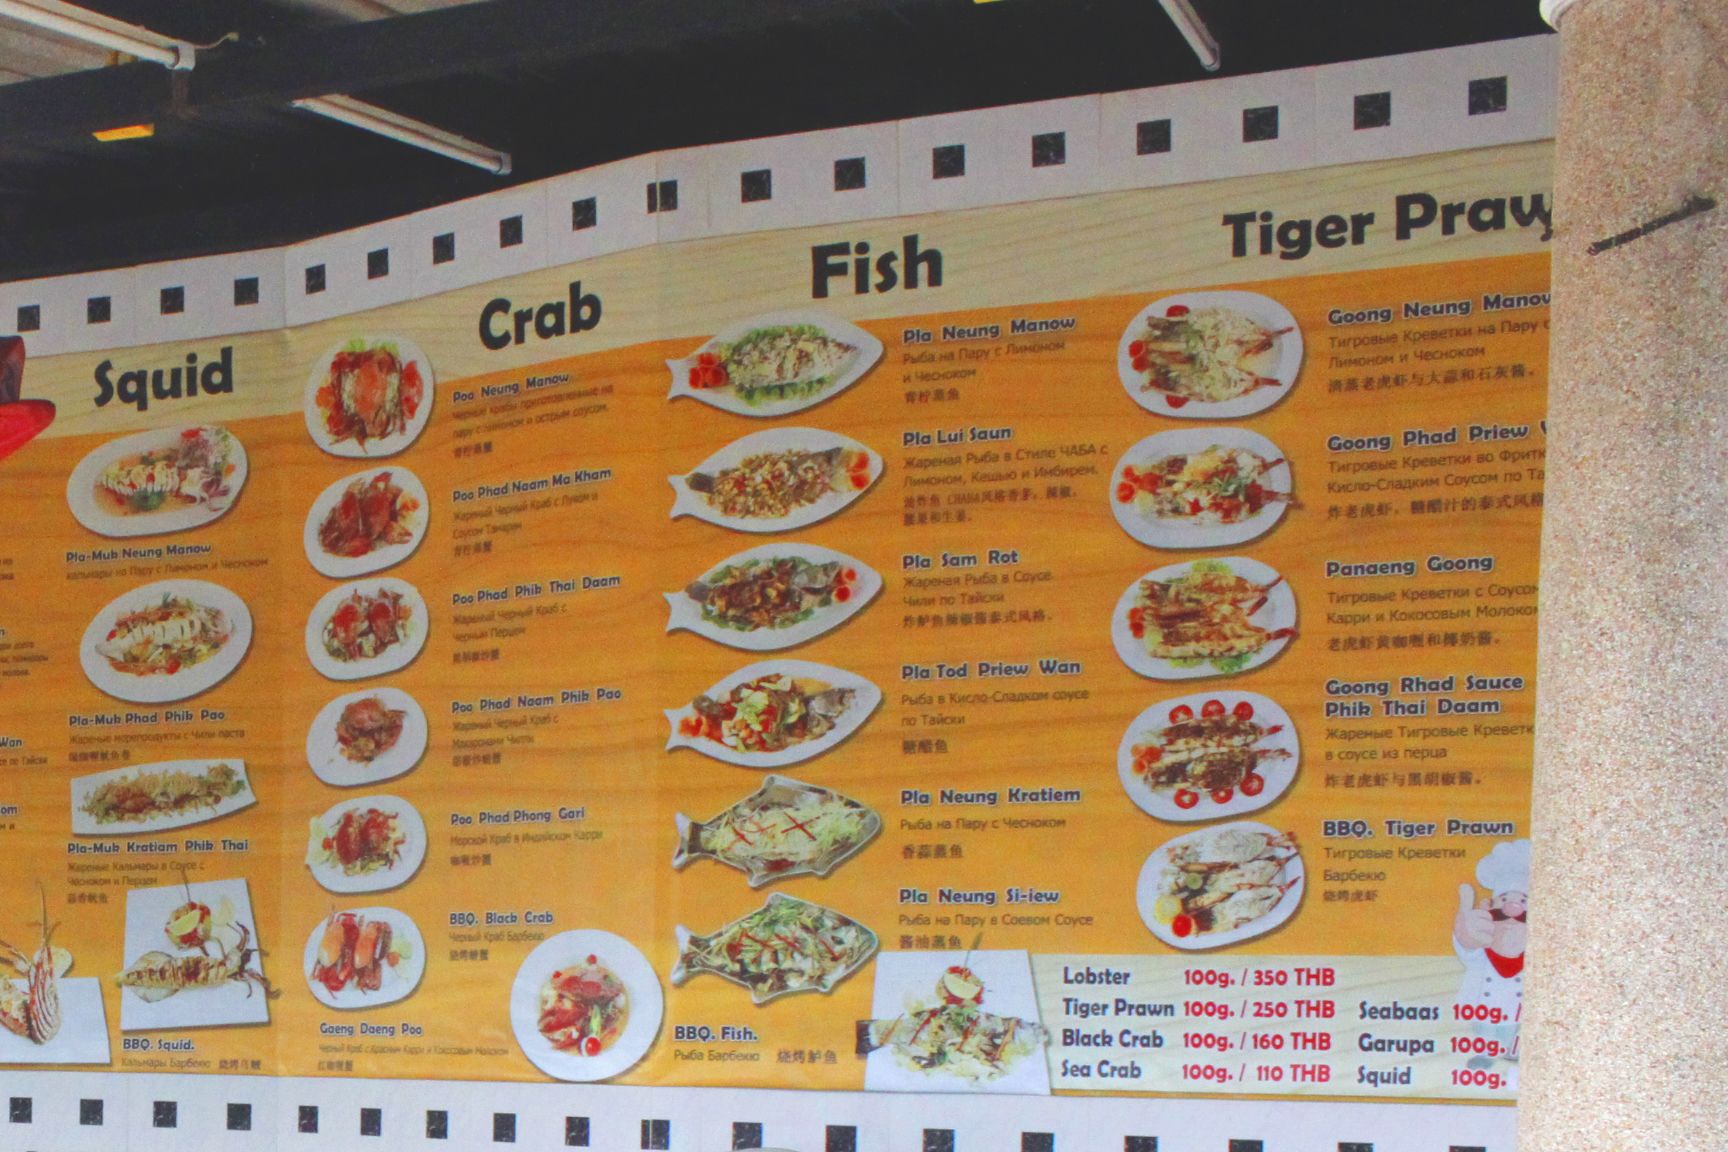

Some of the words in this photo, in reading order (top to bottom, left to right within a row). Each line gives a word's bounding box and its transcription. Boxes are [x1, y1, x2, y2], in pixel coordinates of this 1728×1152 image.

[1222, 209, 1375, 261] Tiger
[812, 234, 943, 298] Fish
[479, 280, 602, 350] Crab
[1329, 309, 1392, 324] Goong
[1404, 301, 1470, 318] Neung
[904, 330, 932, 343] Pla
[943, 325, 1000, 340] Neung
[1011, 318, 1075, 333] Manow
[94, 346, 233, 411] Squid
[453, 391, 474, 403] Poo
[482, 383, 519, 396] Neung
[526, 374, 569, 388] Manow
[904, 432, 931, 445] Pla
[938, 429, 963, 443] Lui
[970, 428, 1011, 441] Saun
[1328, 436, 1391, 450] Goong
[1404, 428, 1456, 445] Phad
[1469, 424, 1528, 440] Priew
[453, 491, 474, 502] Poo
[478, 483, 508, 496] Phad
[513, 479, 548, 491] Naam
[552, 475, 570, 486] Ma
[575, 470, 611, 482] Kham
[123, 548, 162, 560] Neung
[167, 545, 211, 555] Manow
[903, 556, 930, 568] Pla
[942, 553, 976, 567] Sam
[989, 550, 1018, 564] Rot
[1327, 562, 1415, 577] Panaeng
[1427, 557, 1493, 572] Goong
[453, 594, 473, 605] Poo
[478, 588, 507, 601] Phad
[550, 580, 575, 593] Thai
[583, 577, 620, 589] Daam
[902, 667, 930, 679] Pla
[937, 664, 967, 677] Tod
[978, 663, 1028, 676] Priew
[1040, 660, 1080, 673] Wan
[1326, 680, 1389, 695] Goong
[1466, 676, 1522, 690] Sauce
[452, 702, 473, 713] Poo
[480, 698, 511, 710] Phad
[518, 696, 553, 707] Naam
[597, 689, 621, 700] Pao
[1383, 700, 1425, 715] Thai
[1438, 699, 1499, 713] Daam
[126, 713, 157, 723] Phad
[201, 709, 224, 720] Pao
[901, 791, 929, 804] Pla
[940, 790, 997, 804] Neung
[1008, 789, 1080, 802] Kratiem
[451, 814, 472, 825] Poo
[479, 812, 509, 823] Phad
[514, 811, 551, 822] Phong
[1324, 821, 1372, 837] BBQ.
[1385, 821, 1435, 837] Tiger
[1447, 820, 1513, 834] Prawn
[222, 840, 248, 850] Thai
[900, 889, 928, 902] Pla
[939, 889, 995, 904] Neung
[524, 911, 553, 923] Crab
[1064, 967, 1130, 984] Lobster
[1185, 970, 1235, 988] 100g.
[1254, 970, 1287, 985] 350
[1295, 969, 1334, 986] THB
[1062, 998, 1108, 1018] Tiger
[1115, 999, 1174, 1016] Prawn
[1184, 1001, 1235, 1019] 100g.
[1253, 1002, 1287, 1017] 250
[1295, 1000, 1335, 1018] THB
[1359, 1001, 1439, 1020] Seabaas
[1453, 1004, 1508, 1024] 100g.
[320, 1024, 353, 1036] Gaeng
[361, 1023, 395, 1035] Daeng
[402, 1024, 422, 1034] Poo
[675, 1026, 715, 1042] BBQ.
[722, 1026, 758, 1040] Fish.
[1062, 1029, 1113, 1046] Black
[1119, 1030, 1164, 1047] Crab
[1184, 1033, 1234, 1051] 100g.
[1252, 1034, 1283, 1049] 160
[1291, 1032, 1331, 1050] THB
[1359, 1033, 1434, 1056] Garupa
[1451, 1036, 1505, 1057] 100g.
[1062, 1060, 1090, 1077] Sea
[1097, 1060, 1141, 1078] Crab
[1183, 1064, 1232, 1083] 100g.
[1257, 1065, 1283, 1081] 110
[1290, 1065, 1330, 1082] THB
[1357, 1066, 1411, 1087] Squid
[1452, 1070, 1506, 1089] 100g.
